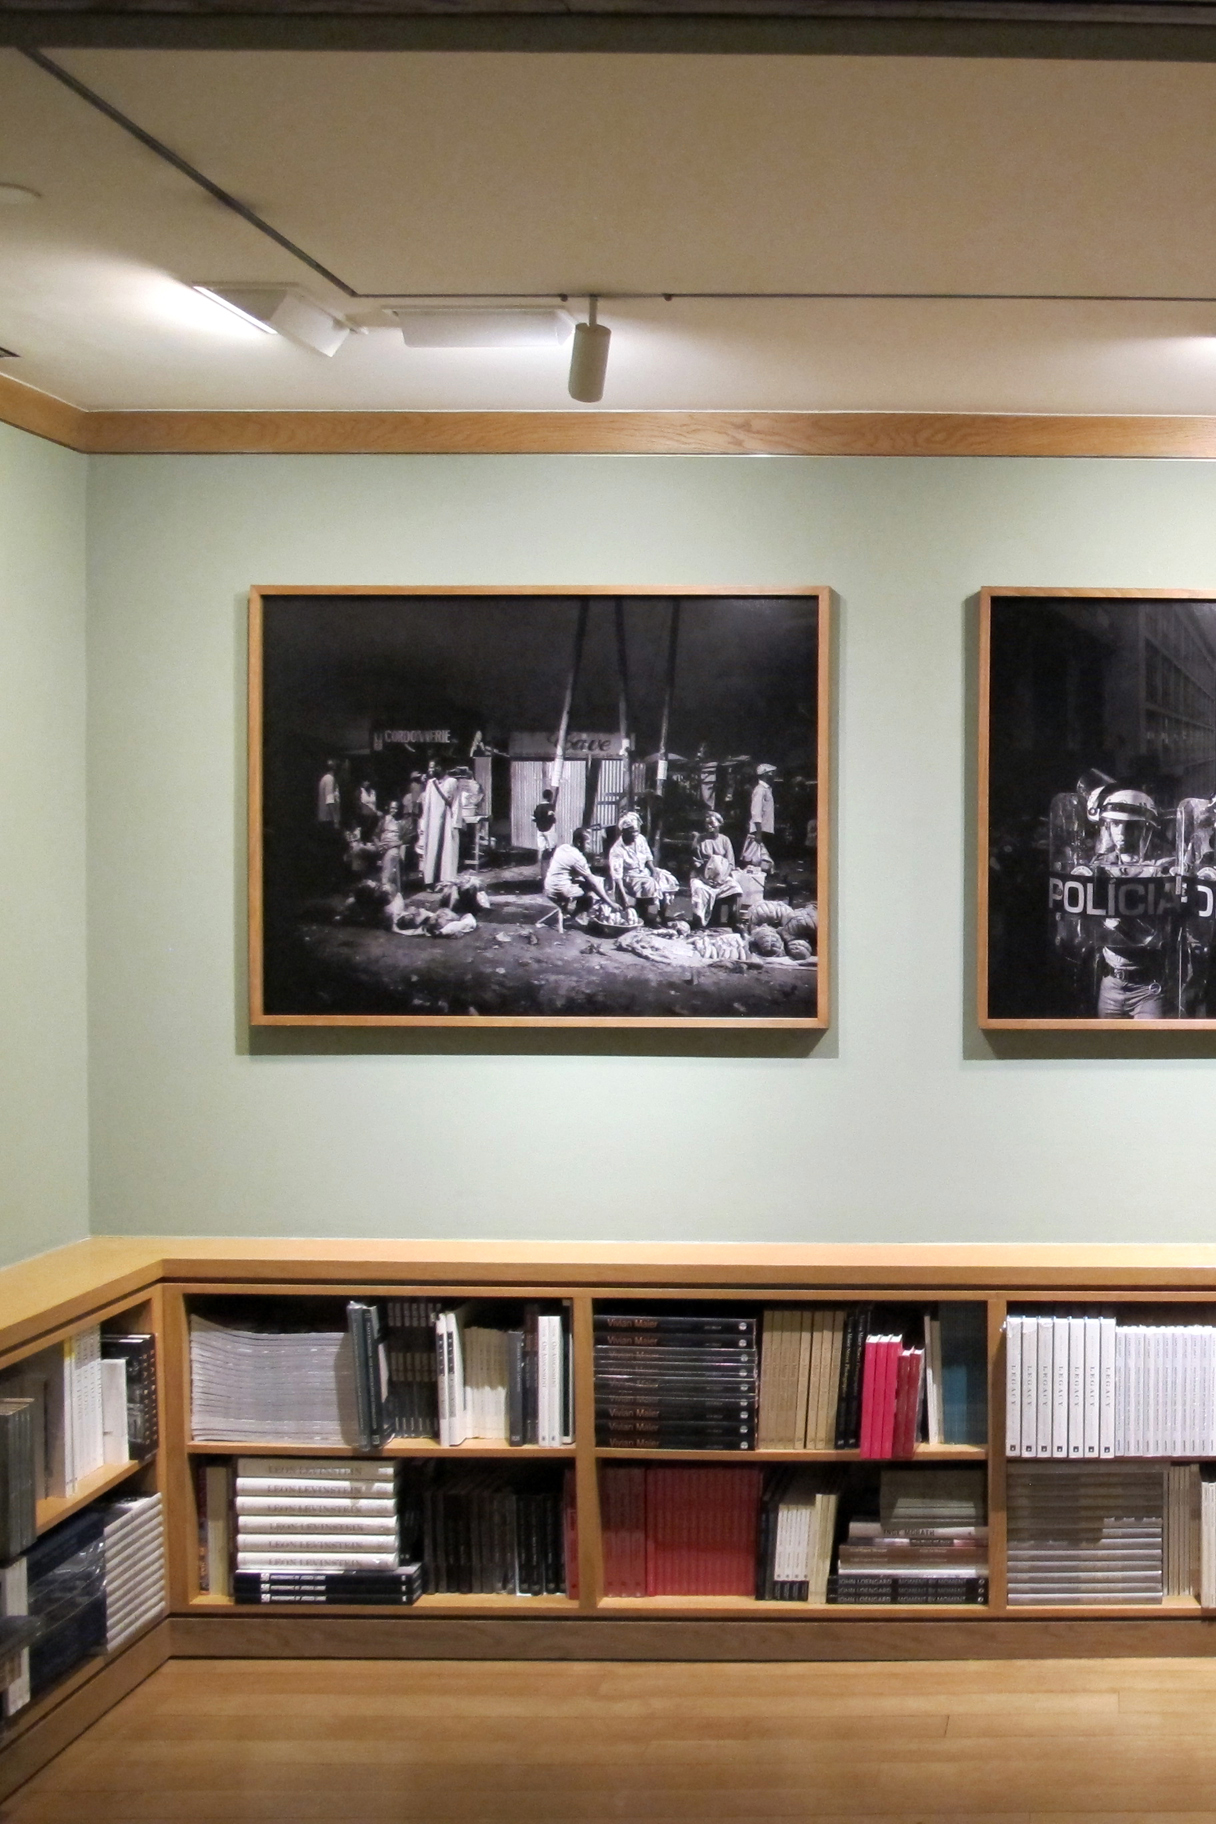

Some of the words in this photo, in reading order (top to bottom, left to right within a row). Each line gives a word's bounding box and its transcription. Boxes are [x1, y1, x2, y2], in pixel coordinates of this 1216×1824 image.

[607, 1318, 632, 1328] Vivian
[634, 1319, 659, 1329] Maier
[607, 1336, 632, 1345] Vivian
[634, 1336, 659, 1346] Maier
[609, 1408, 633, 1417] Vivian
[636, 1409, 660, 1418] Maier
[609, 1422, 633, 1431] Vivian
[636, 1423, 660, 1432] Maier
